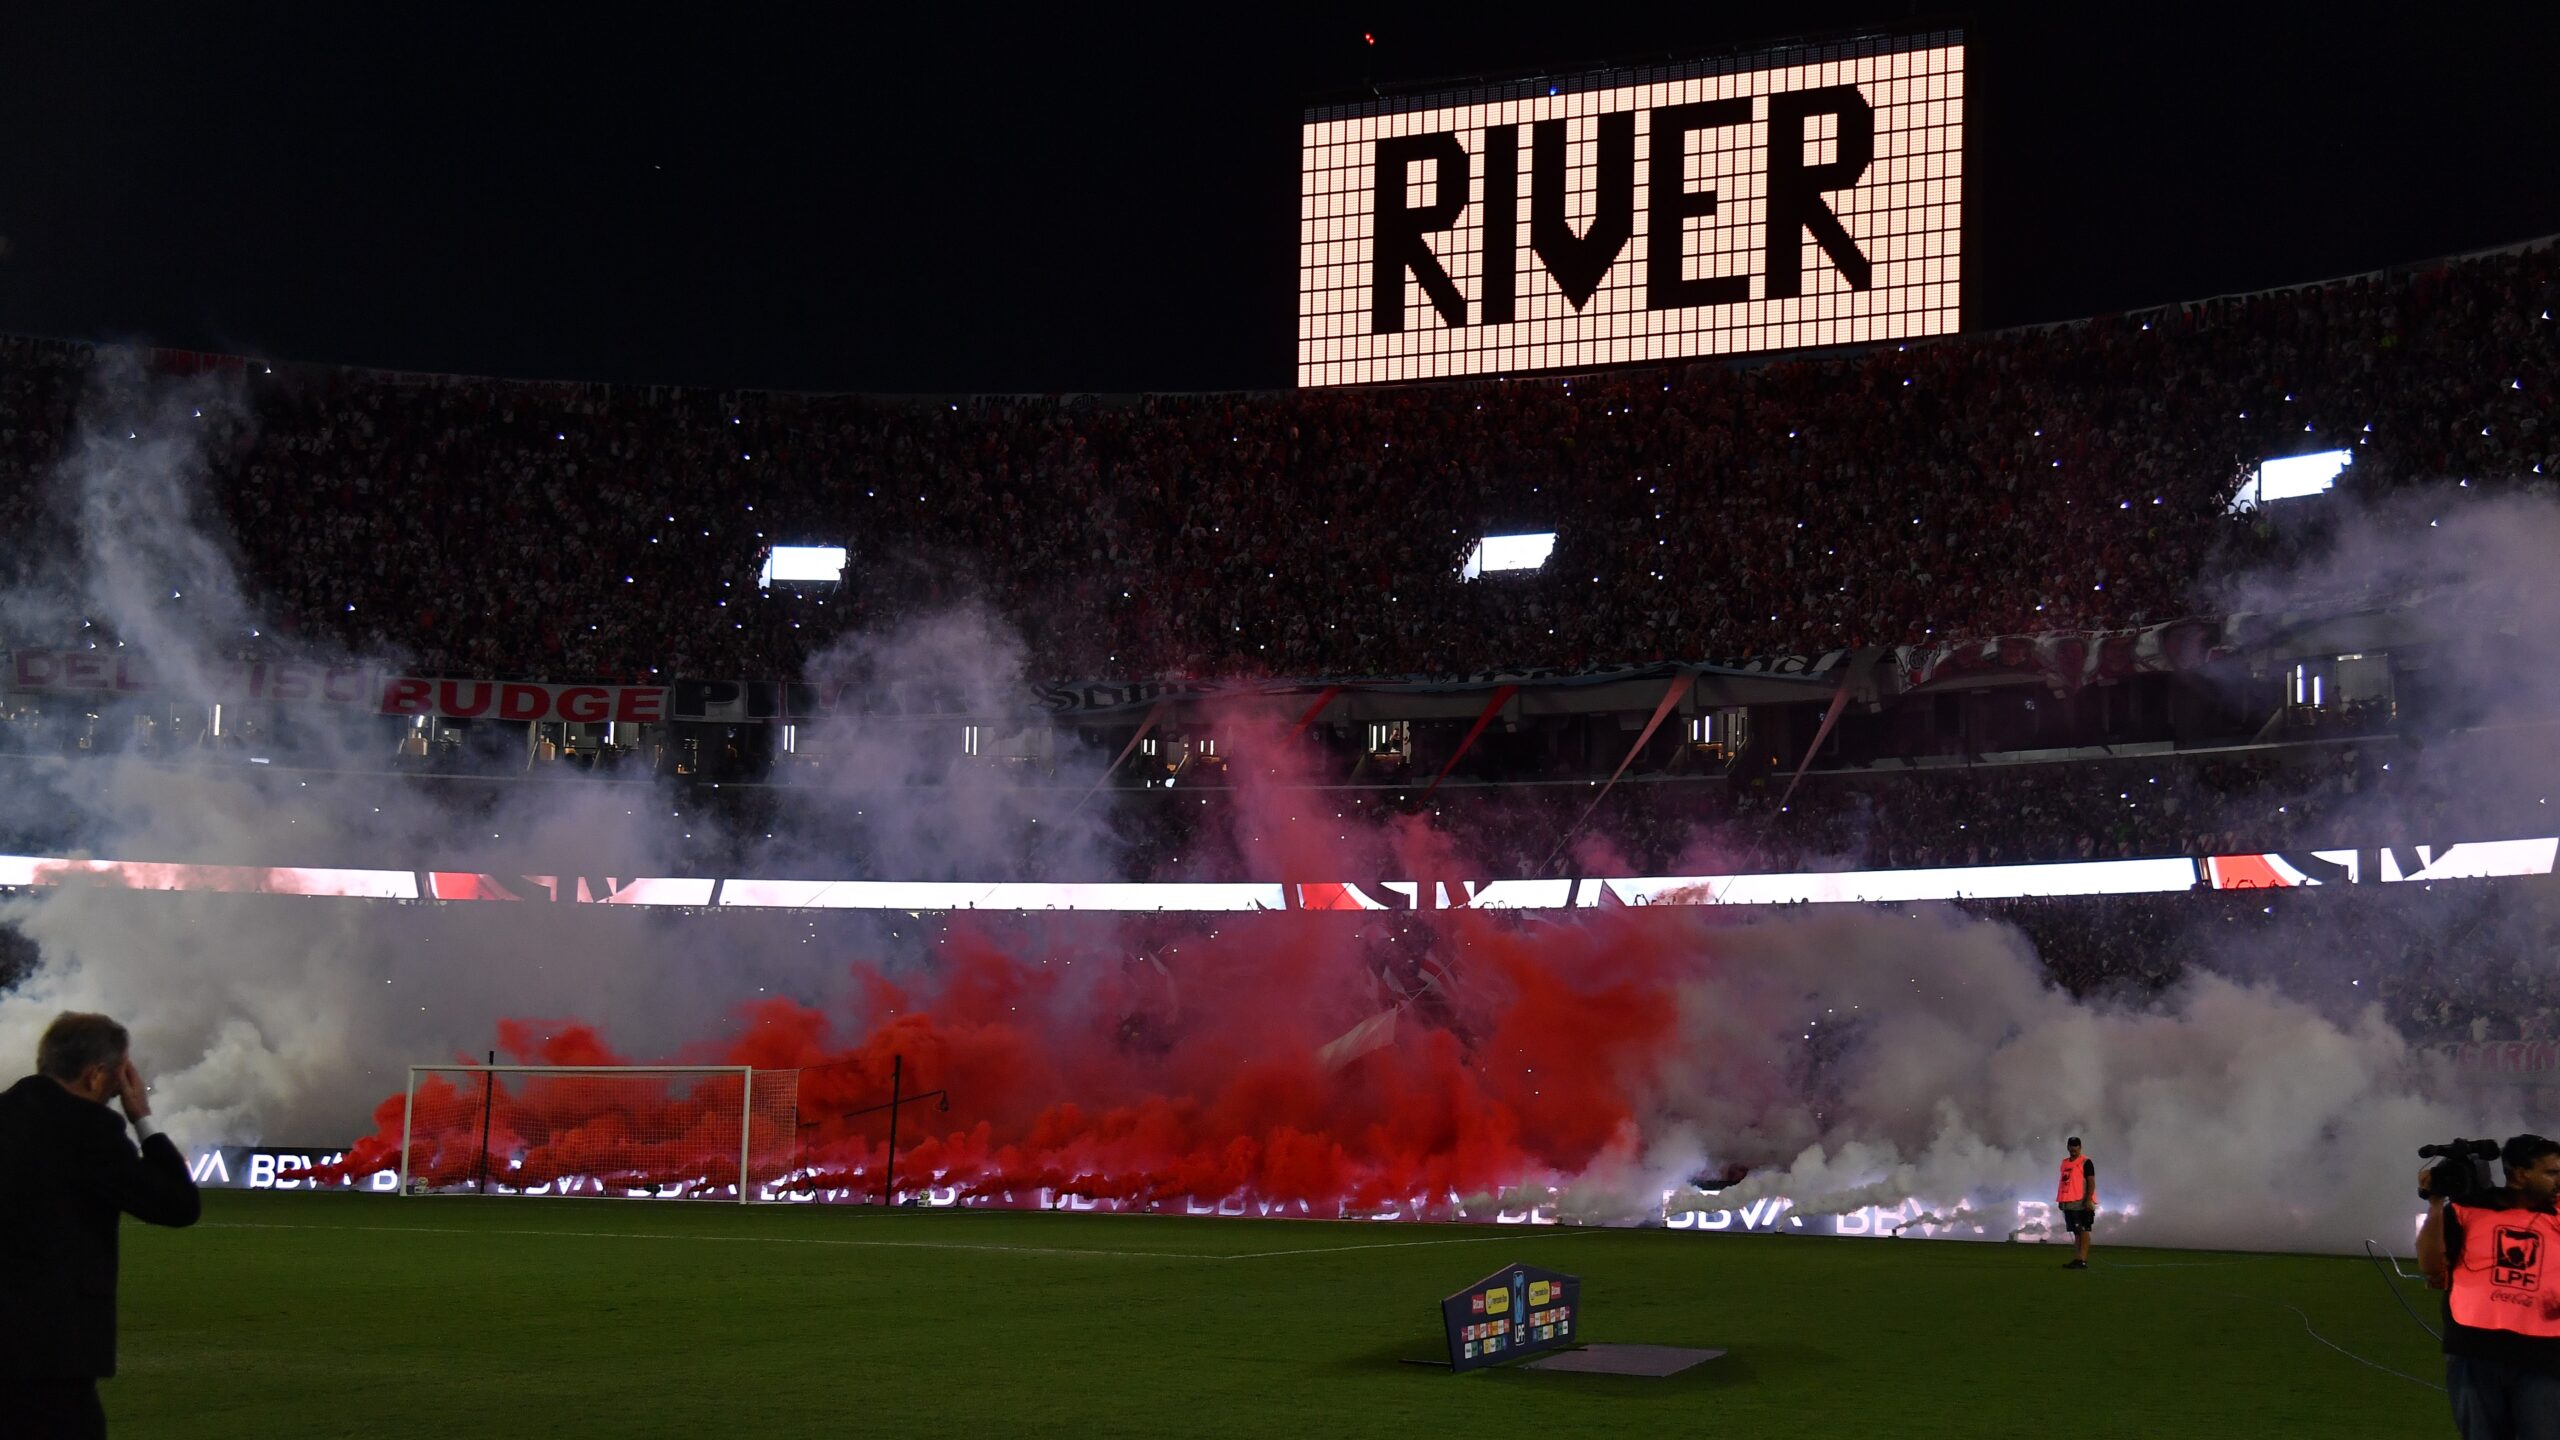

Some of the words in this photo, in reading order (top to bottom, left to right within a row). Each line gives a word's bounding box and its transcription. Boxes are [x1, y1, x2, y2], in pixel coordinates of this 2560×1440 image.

[1372, 84, 1874, 334] RIVER
[17, 652, 150, 690] DEL
[381, 678, 664, 722] BUDGE
[2495, 1268, 2536, 1287] LPF
